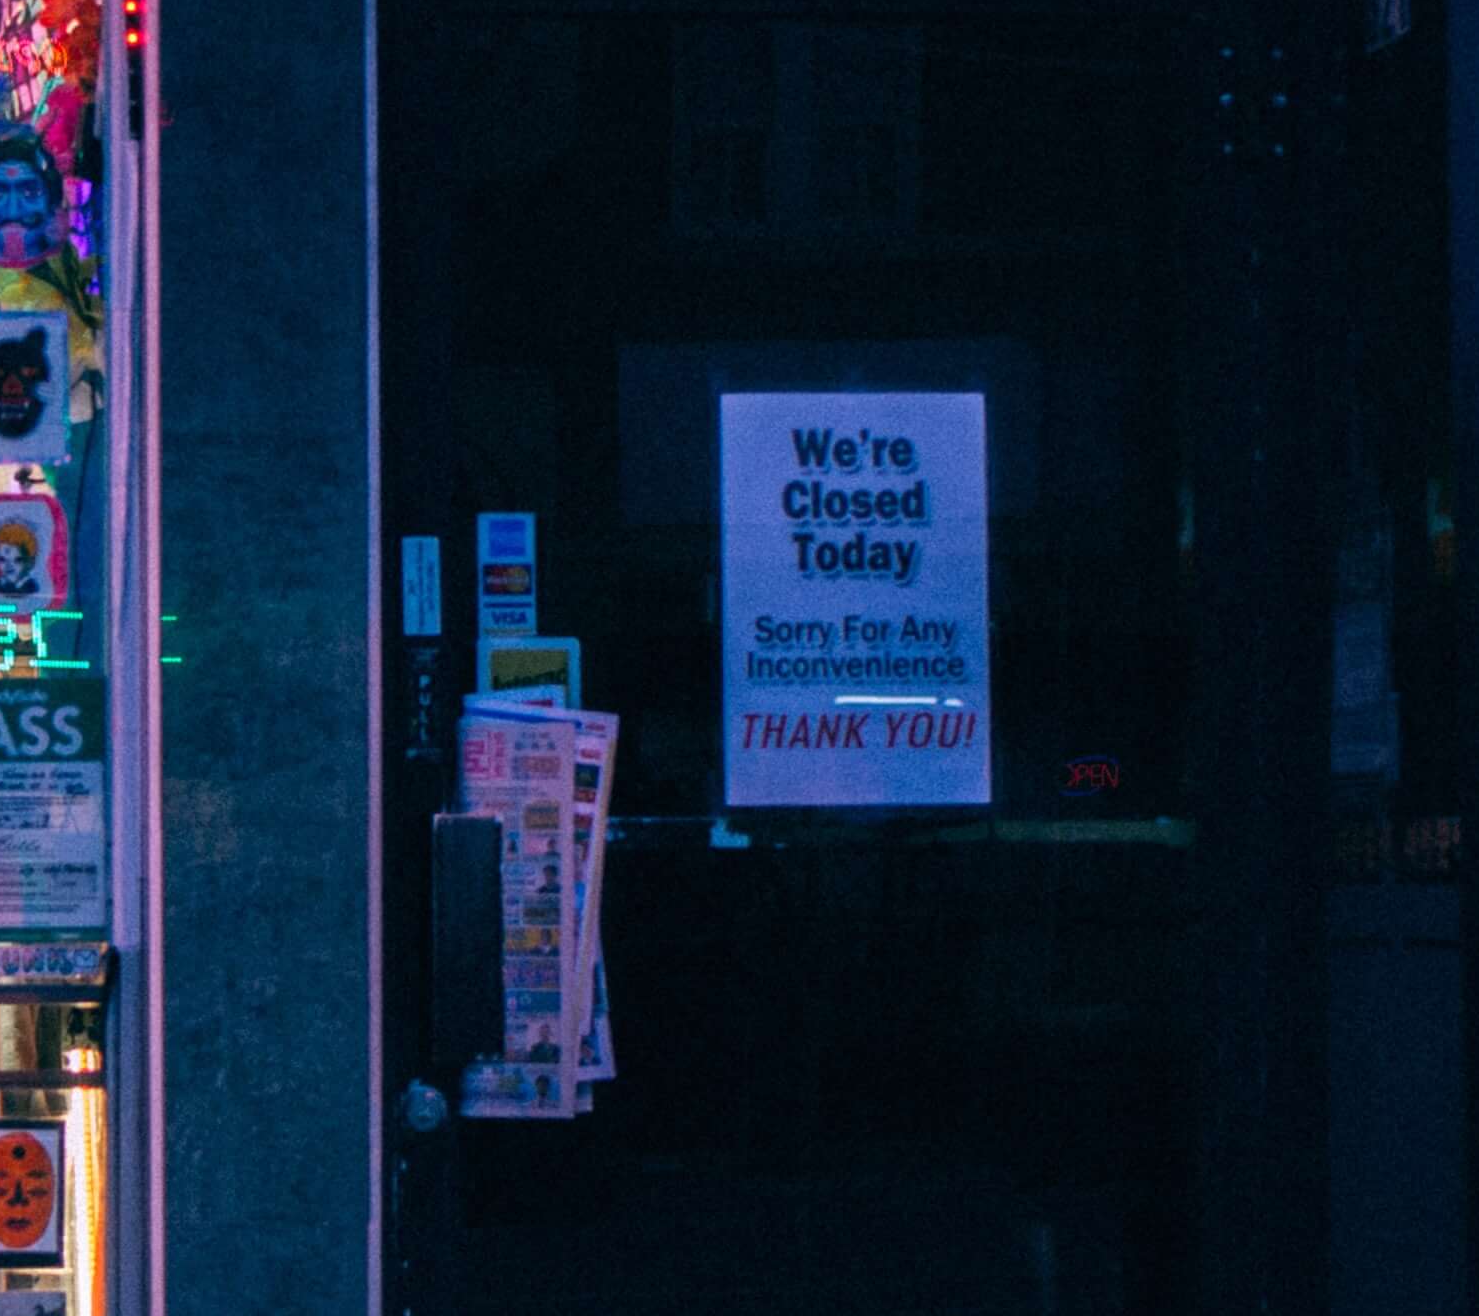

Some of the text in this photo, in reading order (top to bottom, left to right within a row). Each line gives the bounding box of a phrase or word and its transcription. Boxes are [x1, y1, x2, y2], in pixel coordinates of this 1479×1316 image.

[792, 428, 917, 473] We're
[782, 481, 928, 525] Closed
[794, 534, 919, 584] Today
[493, 612, 526, 624] VISA
[755, 615, 957, 648] Sorry For Any
[747, 651, 965, 681] Inconvenience
[744, 711, 975, 750] THANK YOU!
